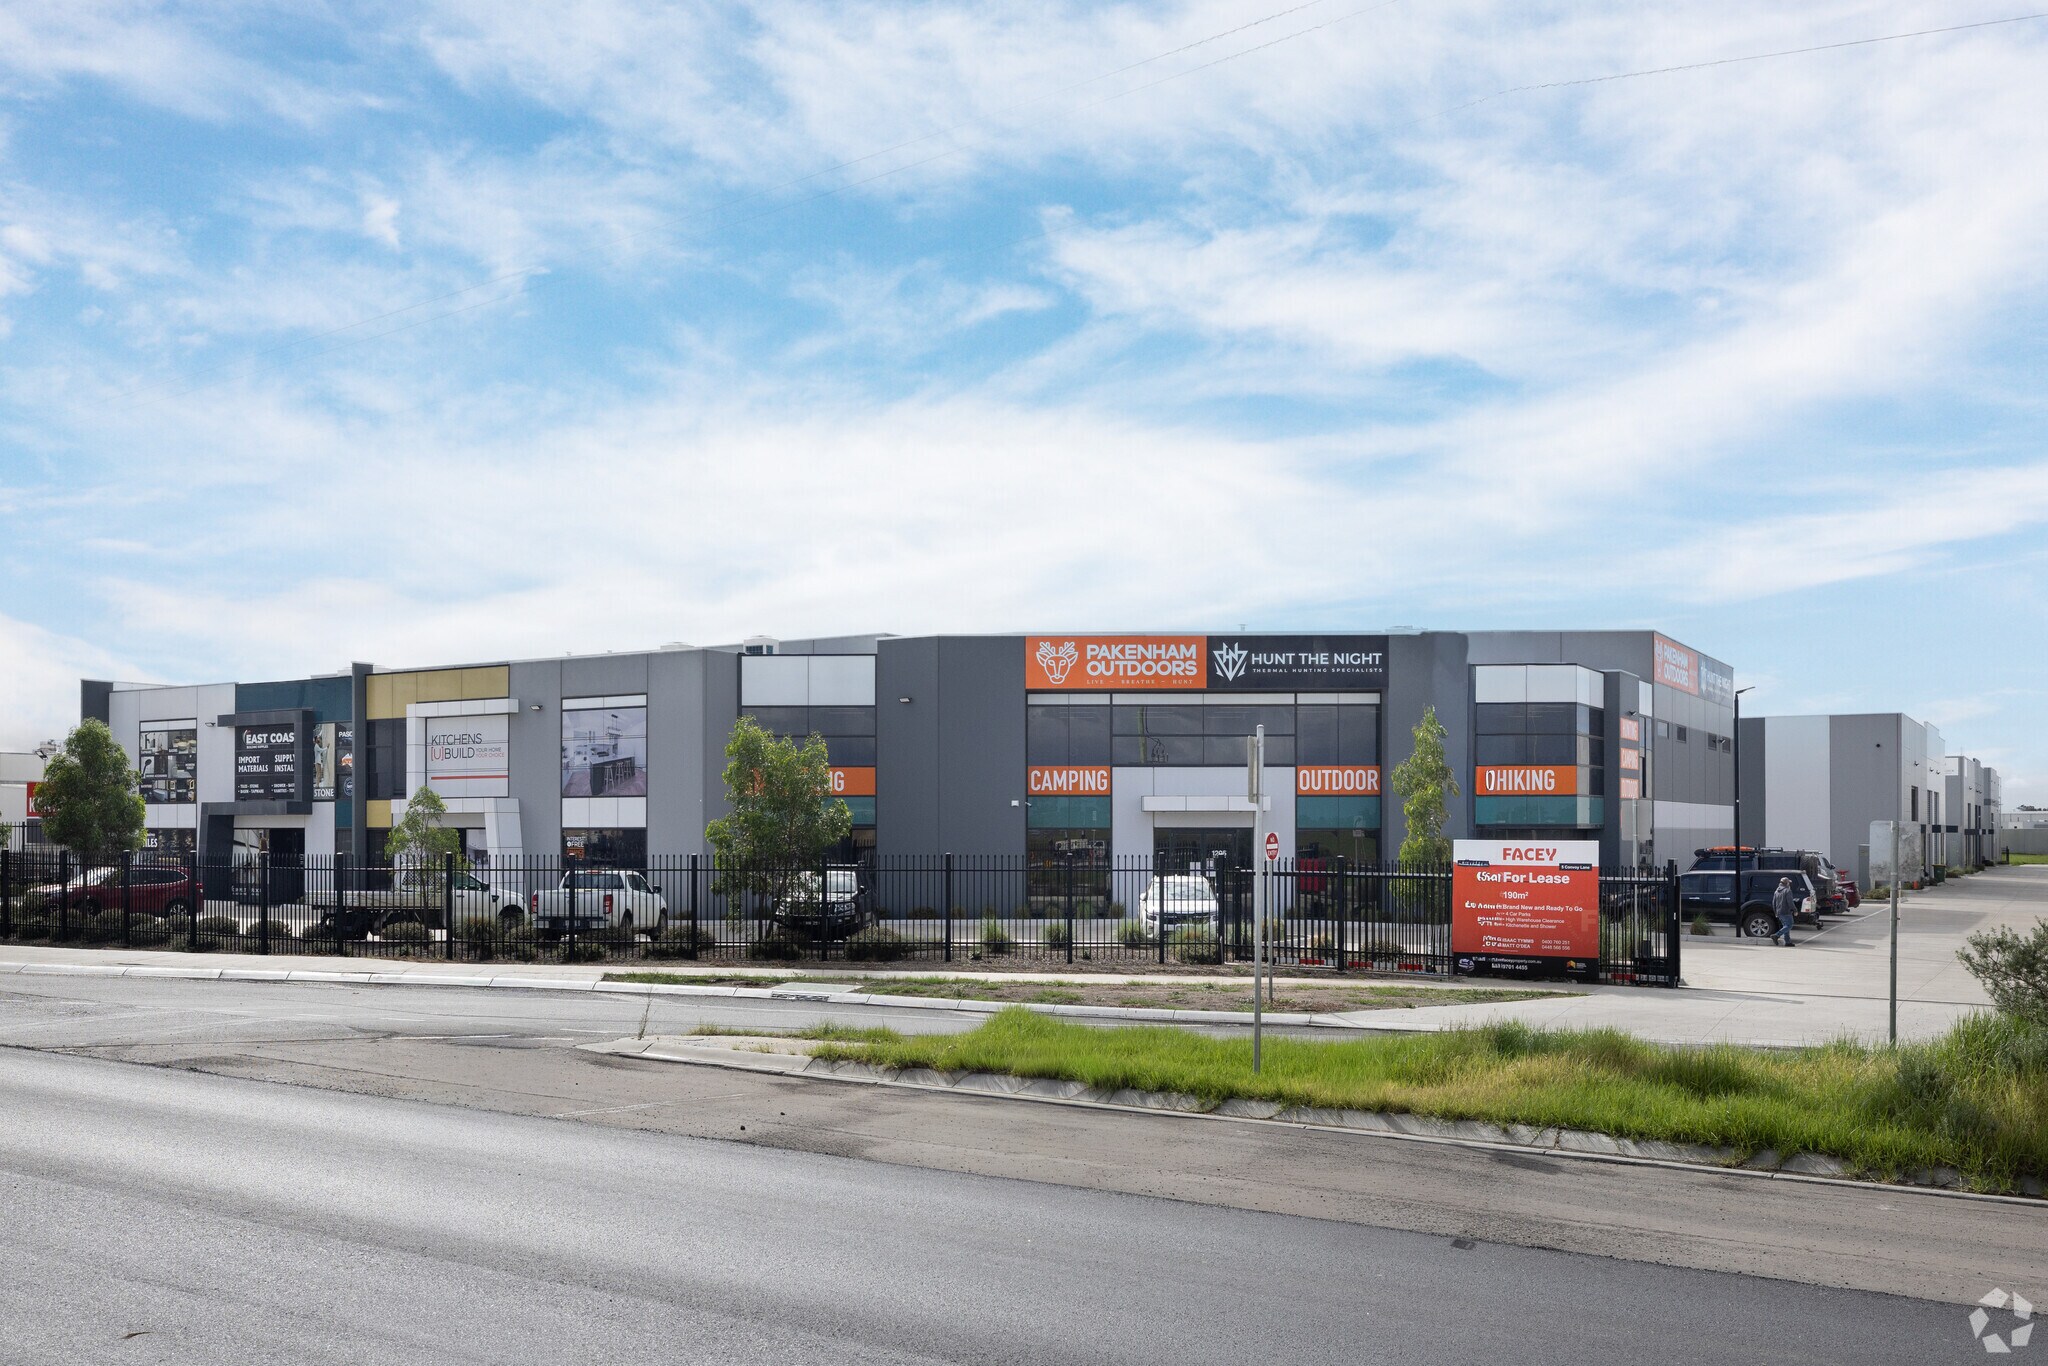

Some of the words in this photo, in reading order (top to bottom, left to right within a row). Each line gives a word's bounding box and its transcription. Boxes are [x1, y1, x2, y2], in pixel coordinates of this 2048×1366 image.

[1086, 644, 1197, 660] PAKENHAM
[1251, 653, 1295, 665] HUNT
[1299, 653, 1329, 665] THE
[1333, 653, 1383, 665] NIGHT
[1086, 660, 1198, 676] OUTDOORS
[1663, 662, 1689, 687] OUTDOORS
[245, 733, 269, 744] EAST
[270, 732, 295, 743] COAS
[431, 733, 483, 746] KITCHENS
[238, 755, 260, 764] IMPORT
[238, 764, 269, 773] MATERIALS
[1030, 770, 1108, 791] CAMPING
[1299, 769, 1379, 791] OUTDOOR
[313, 788, 335, 797] STONE
[1502, 847, 1557, 861] FACEY
[1503, 872, 1526, 883] For
[1528, 872, 1571, 884] Lease
[1546, 904, 1564, 913] Ready
